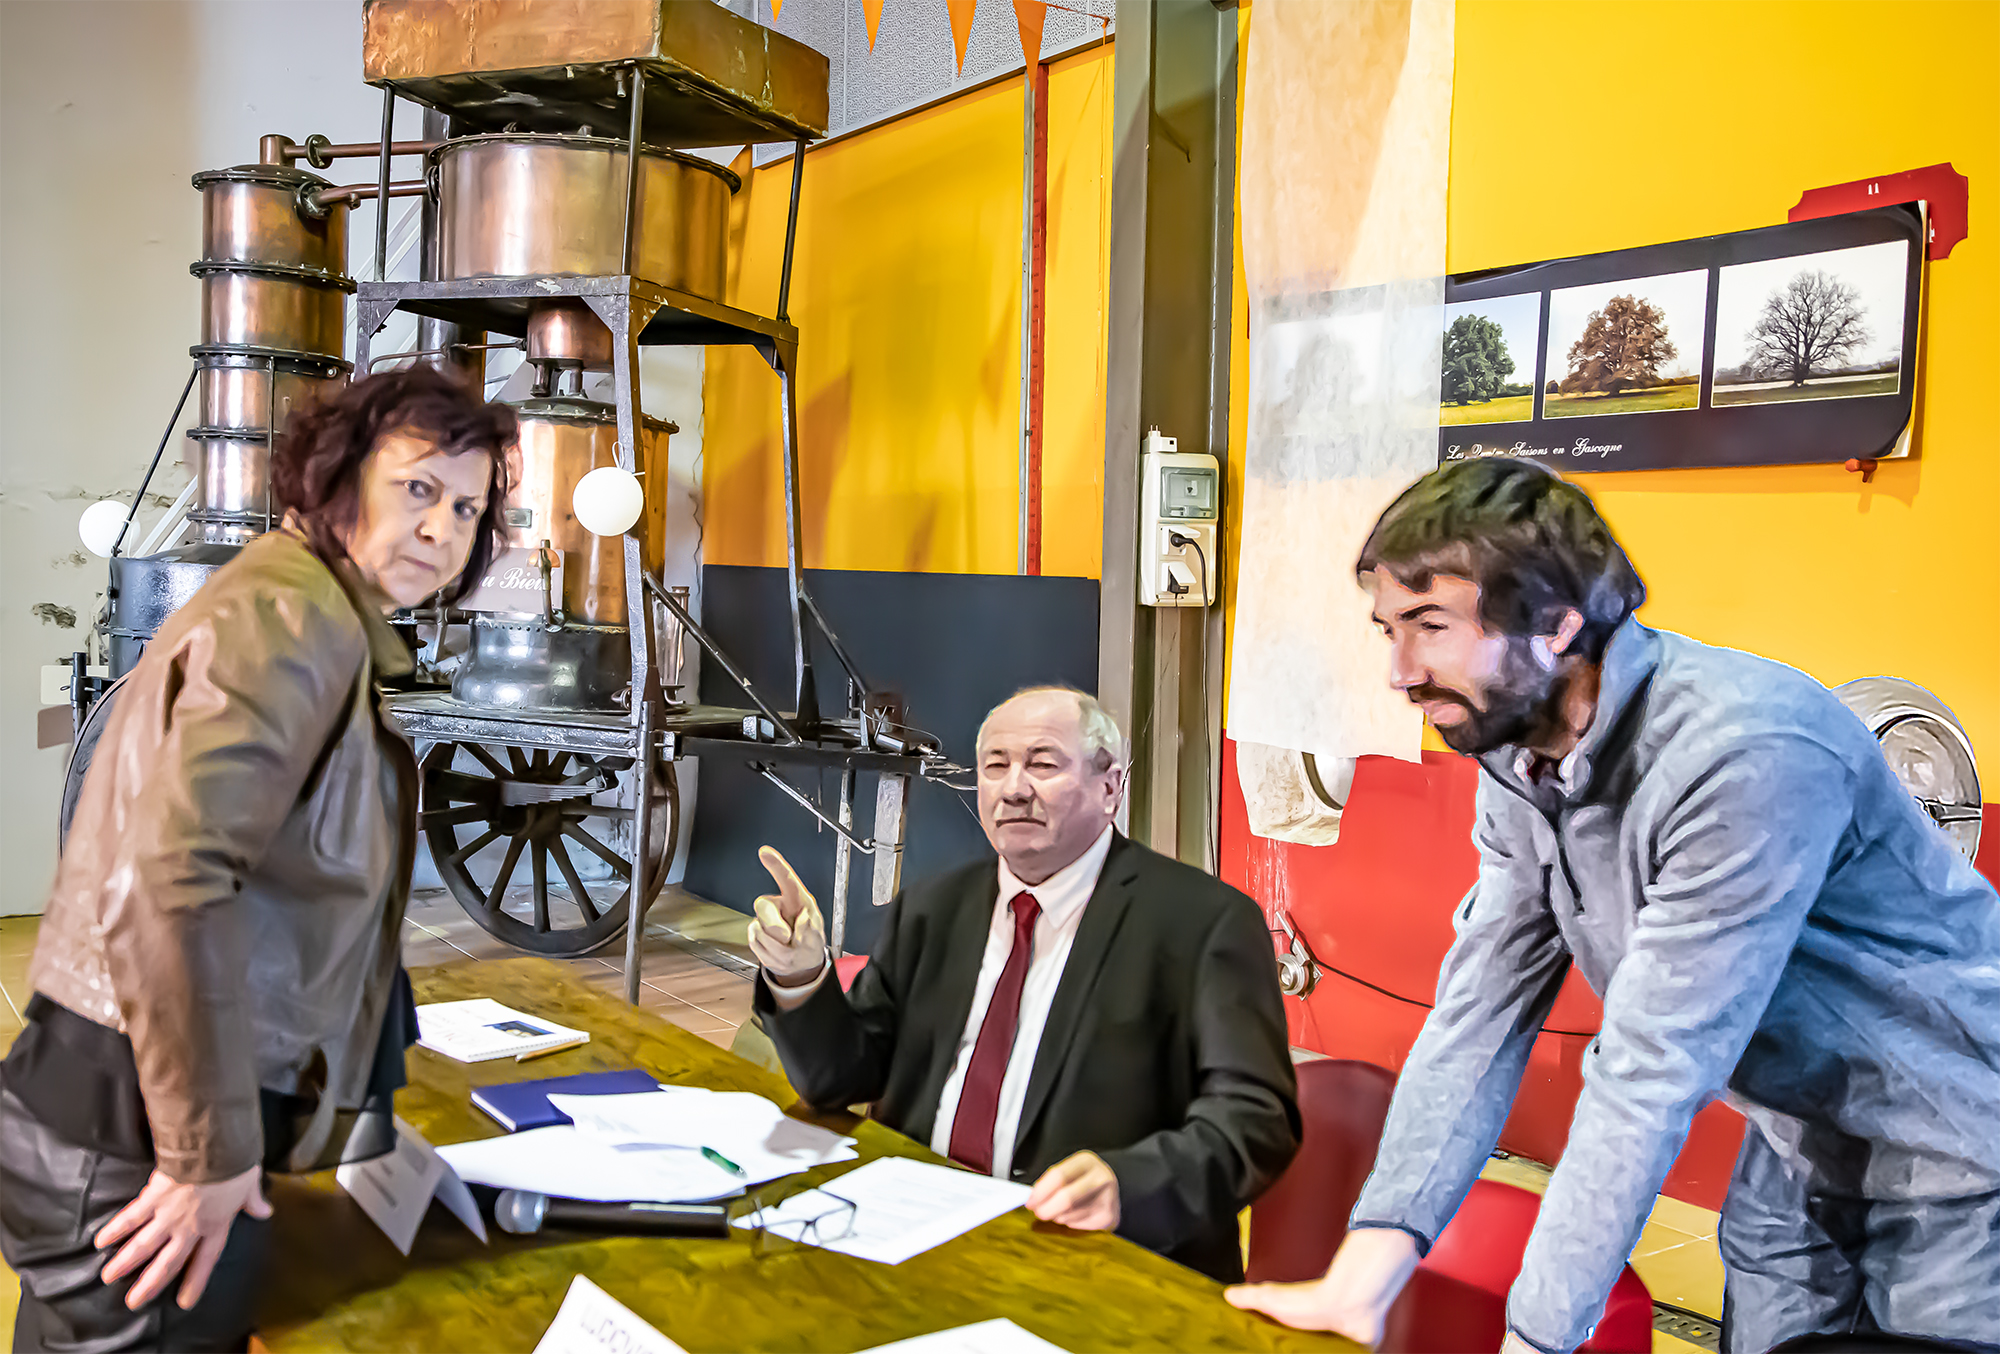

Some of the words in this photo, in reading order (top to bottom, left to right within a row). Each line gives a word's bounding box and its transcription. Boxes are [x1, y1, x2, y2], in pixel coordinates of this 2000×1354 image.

[1446, 444, 1465, 460] Les
[1509, 441, 1548, 457] Saisons
[1552, 446, 1565, 455] en
[1571, 437, 1622, 458] Gascogne
